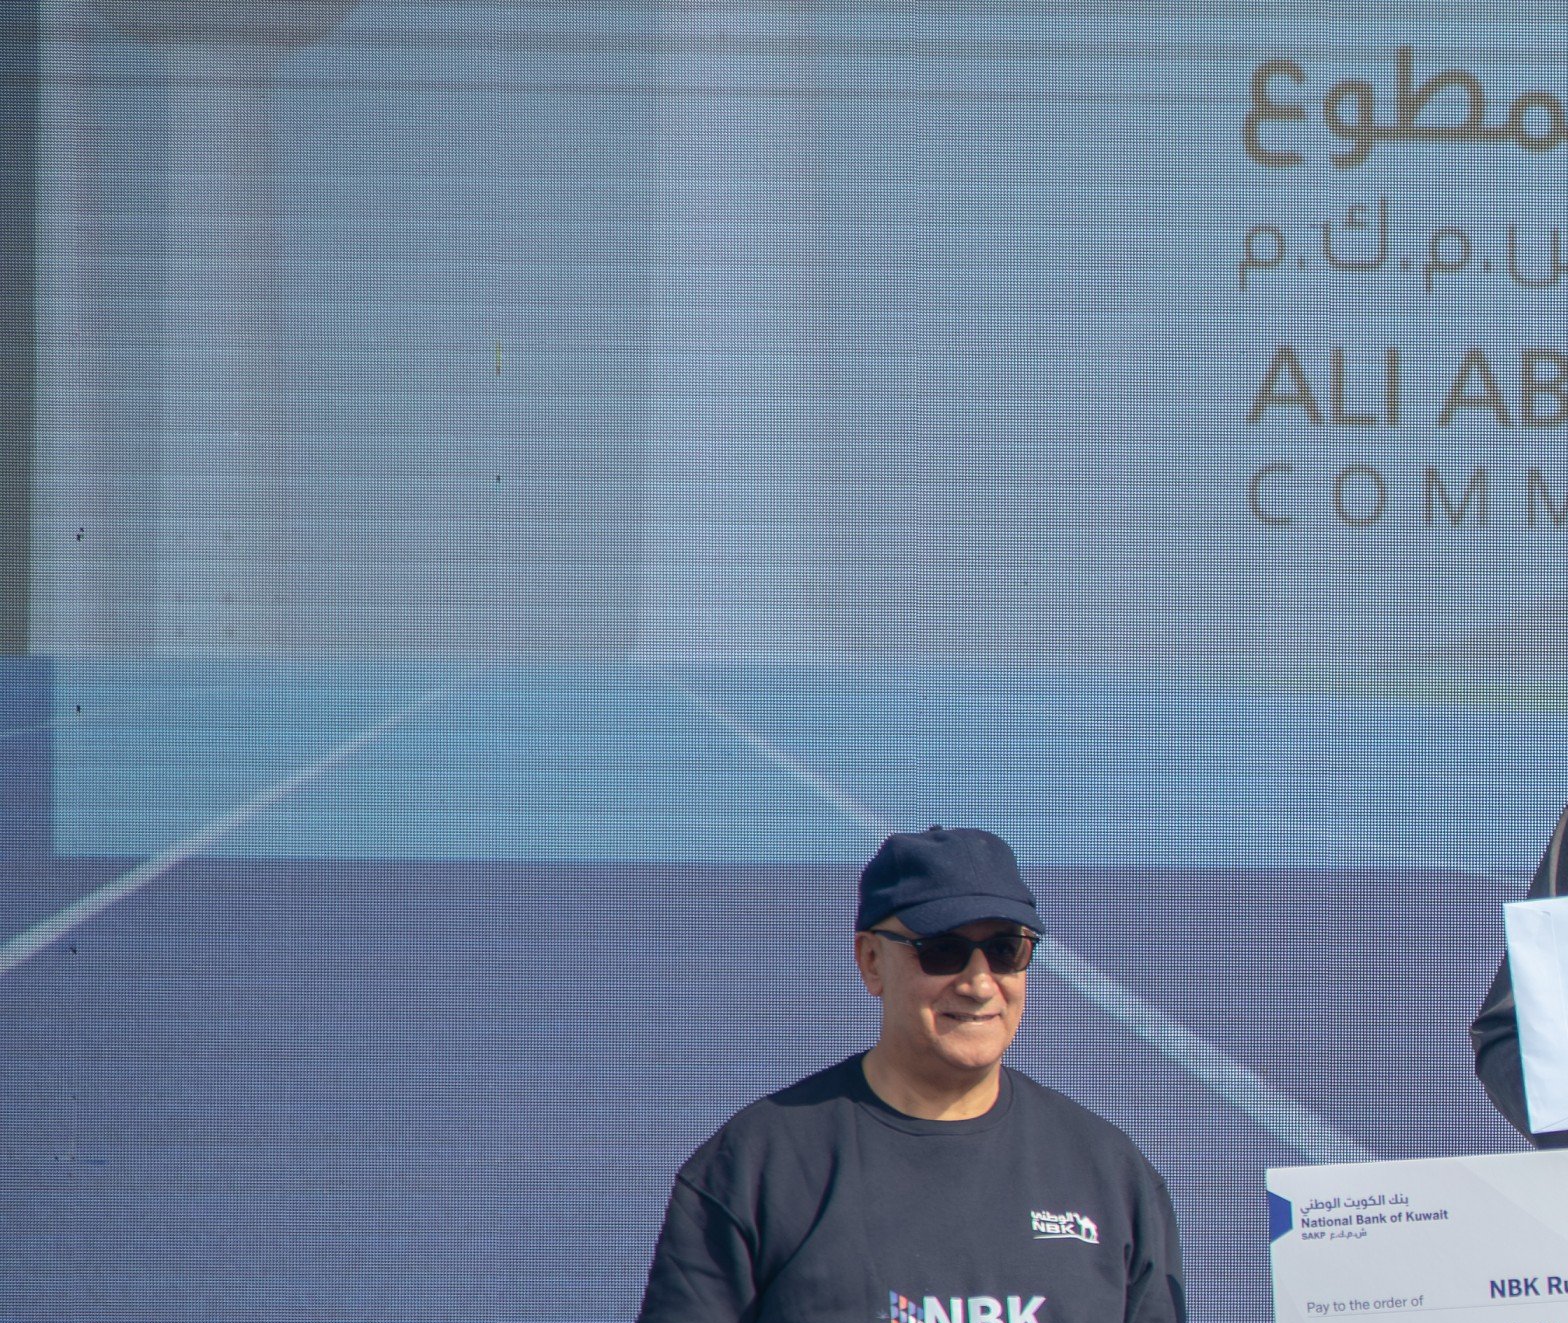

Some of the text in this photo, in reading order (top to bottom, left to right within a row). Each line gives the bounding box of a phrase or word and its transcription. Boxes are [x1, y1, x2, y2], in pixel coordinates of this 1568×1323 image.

[1247, 347, 1401, 426] ALI
[1032, 1221, 1076, 1235] NBK
[1301, 1209, 1449, 1229] National Bank Kuwait
[1490, 1277, 1540, 1298] NBK
[1307, 1296, 1408, 1315] Pay the order
